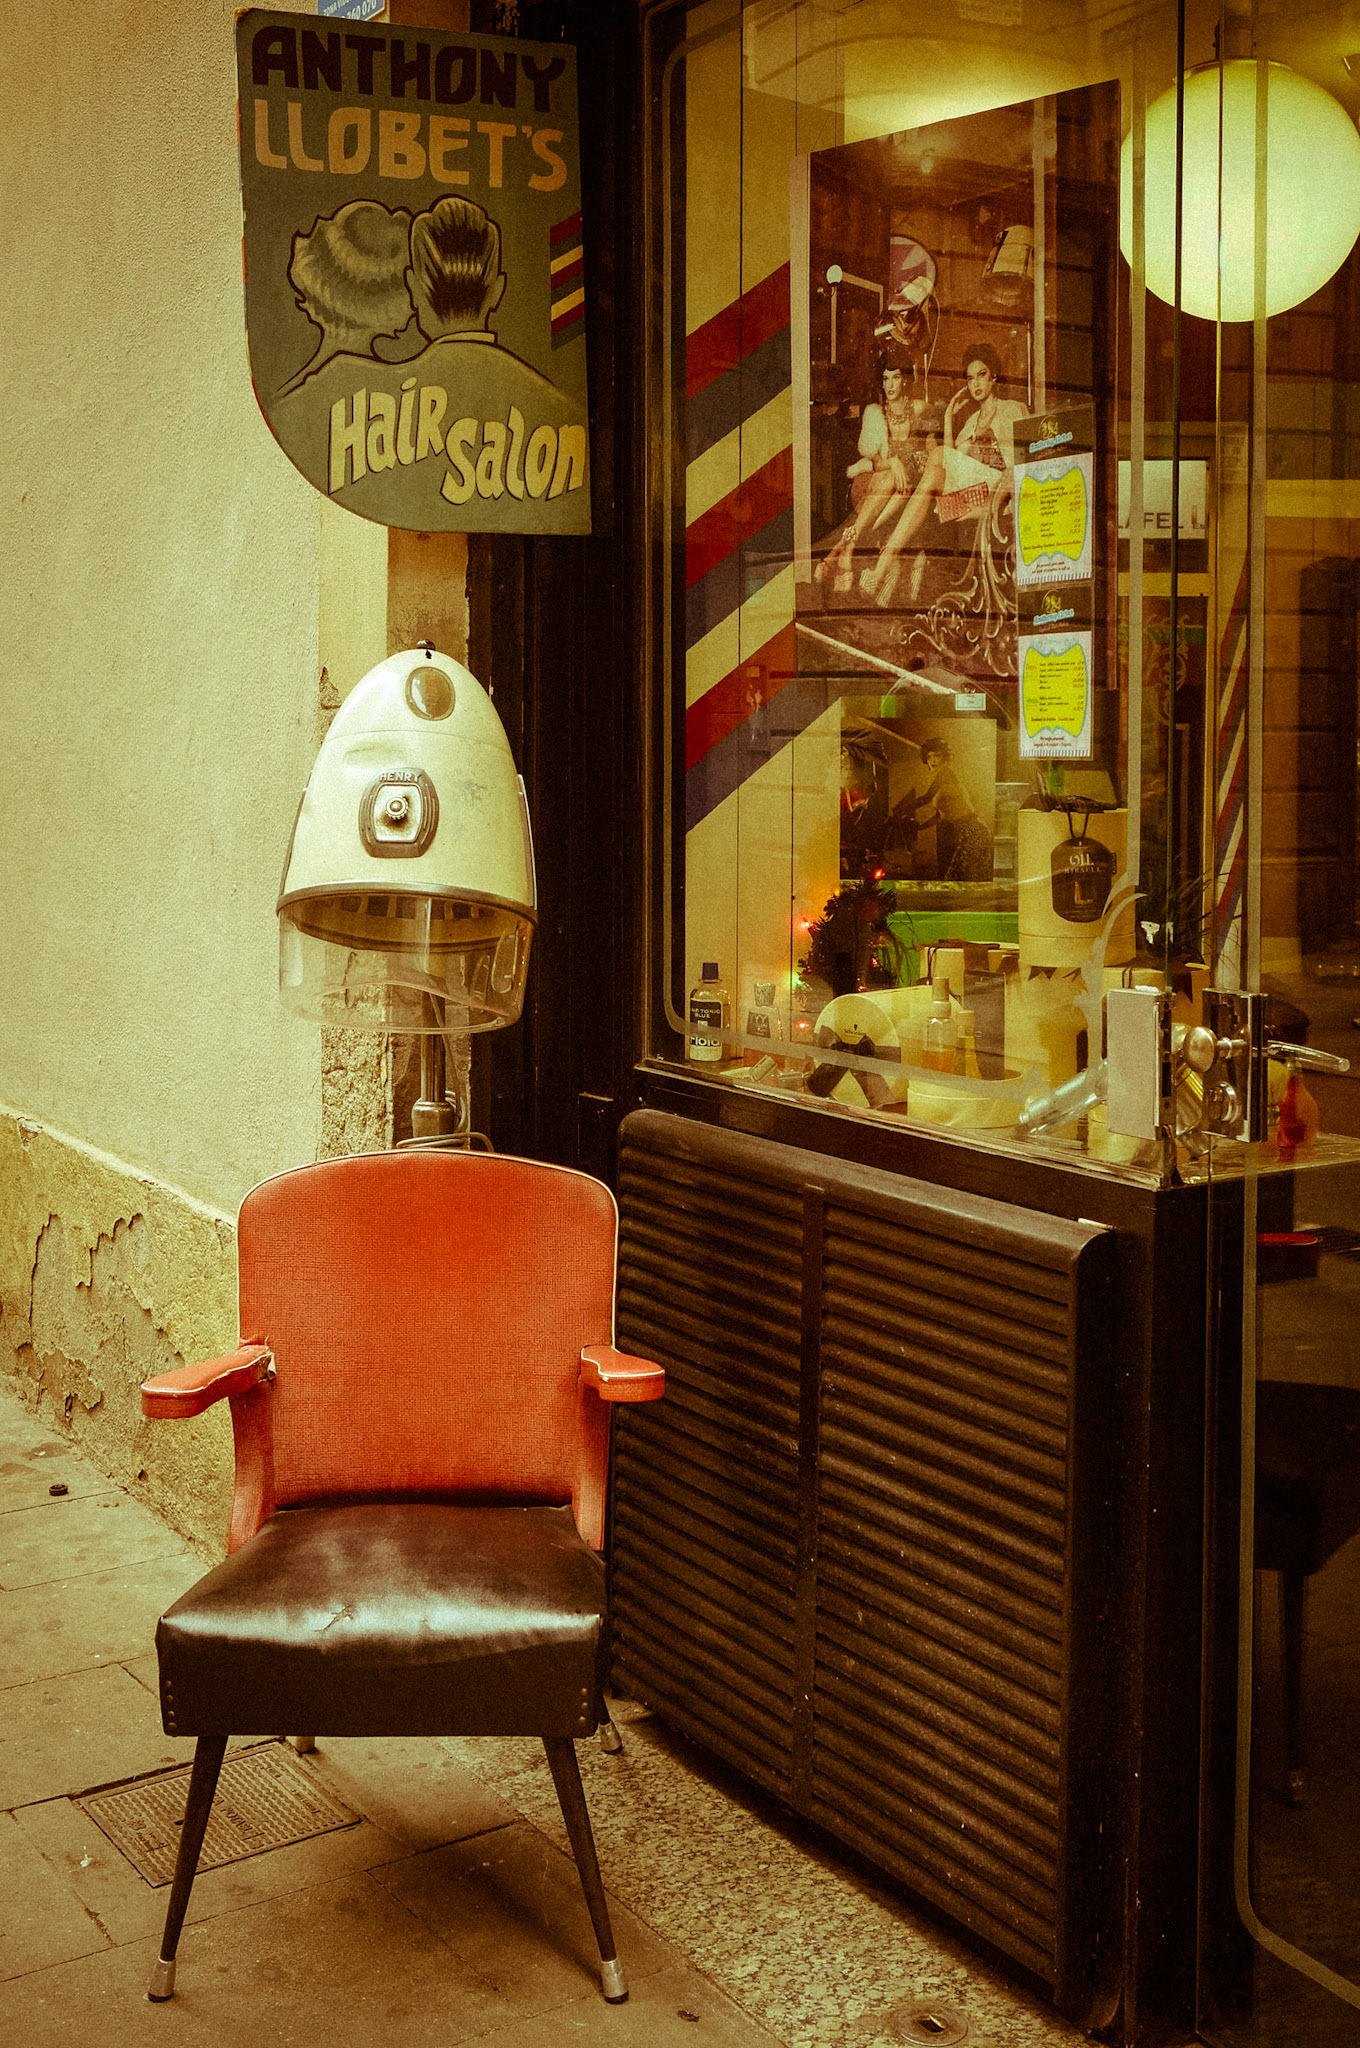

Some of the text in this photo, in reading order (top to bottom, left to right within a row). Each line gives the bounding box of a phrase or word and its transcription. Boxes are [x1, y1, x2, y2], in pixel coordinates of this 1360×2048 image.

[252, 25, 566, 113] ANTHONY
[254, 99, 568, 192] LLOBET'S
[379, 771, 423, 782] HENRY
[1069, 854, 1094, 866] OIL
